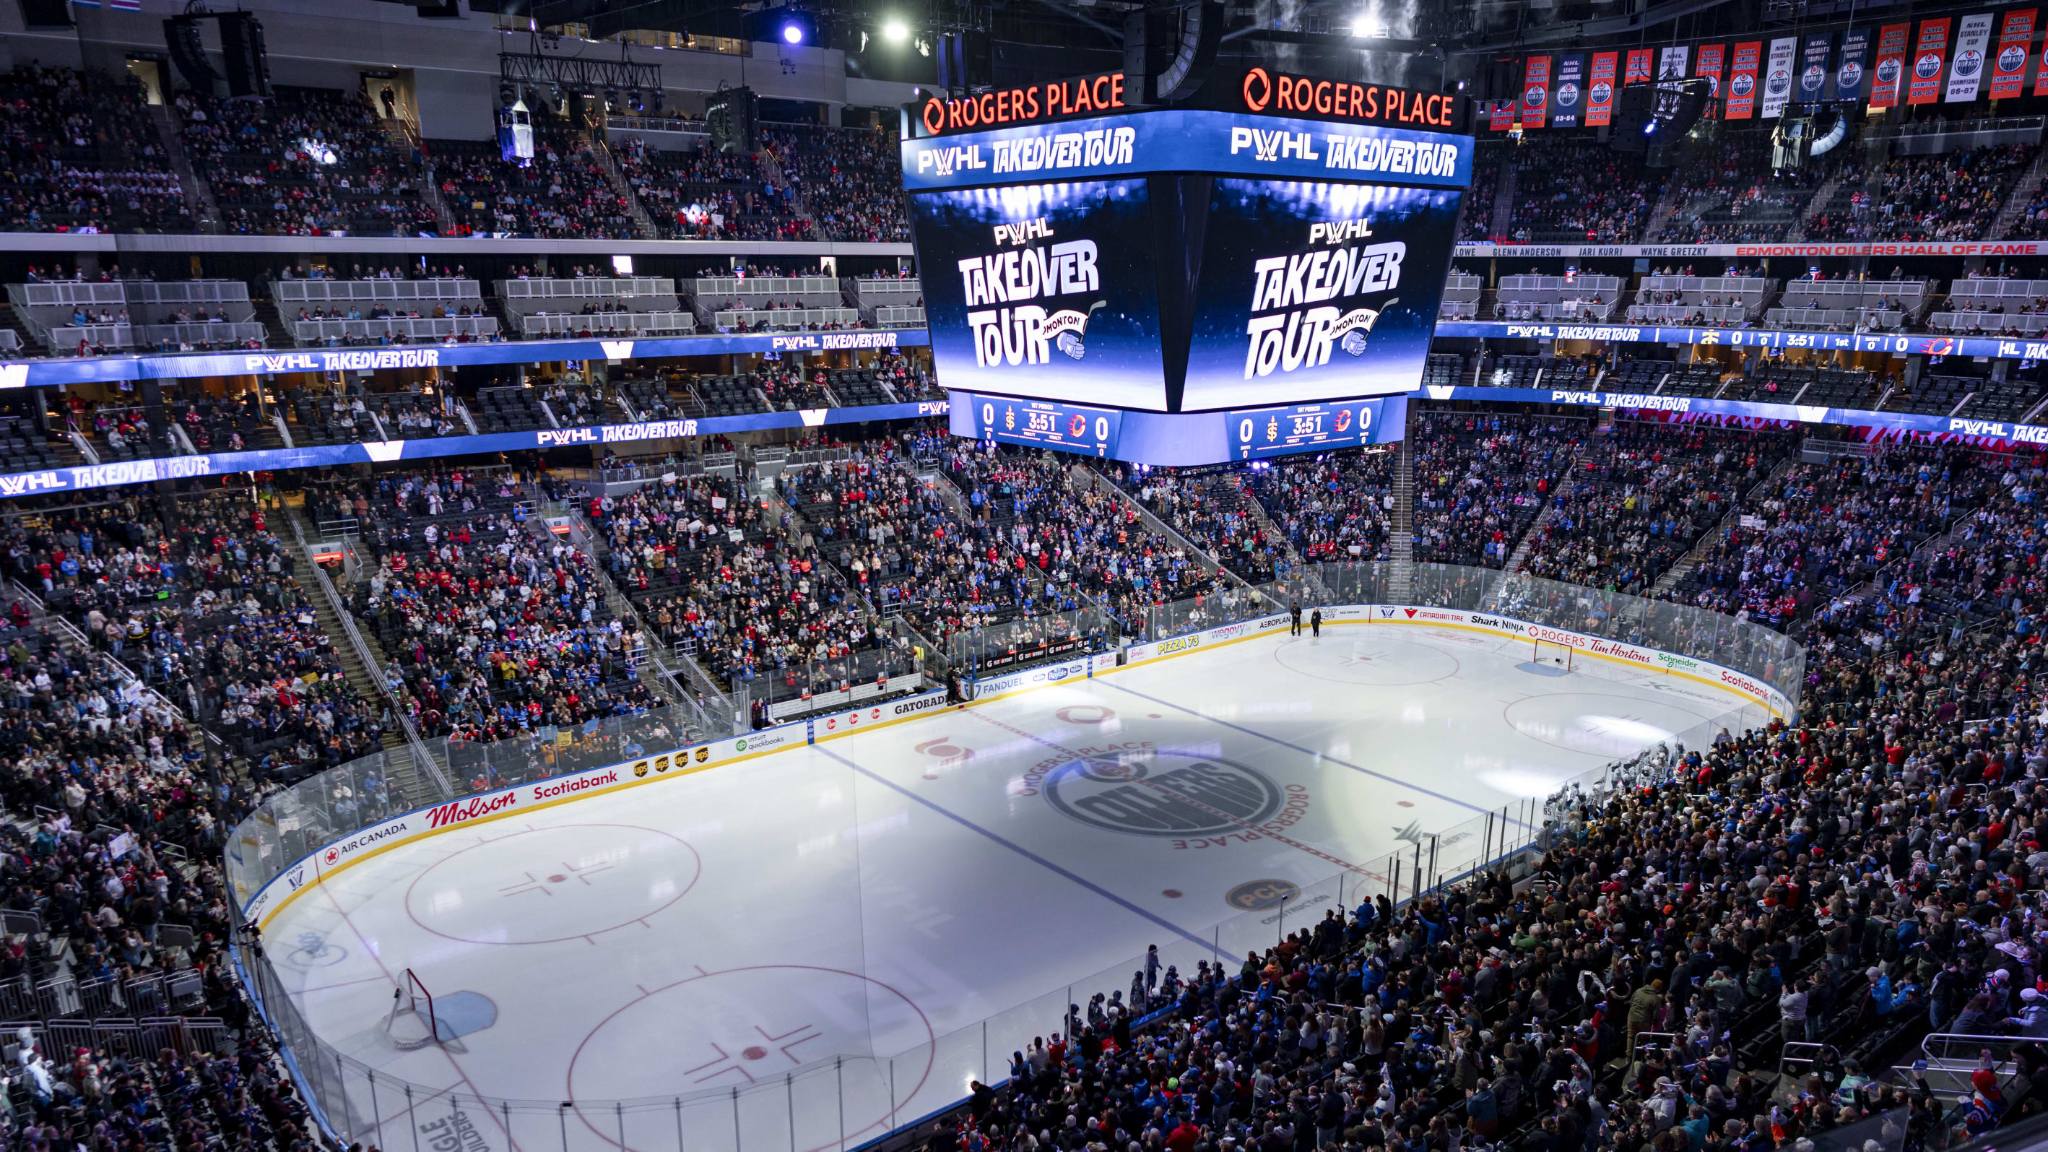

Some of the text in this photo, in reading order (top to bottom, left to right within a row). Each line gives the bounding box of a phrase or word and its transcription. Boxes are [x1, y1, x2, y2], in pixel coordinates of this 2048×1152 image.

[1960, 29, 1988, 38] STANLEY
[2002, 33, 2031, 43] DIVISION
[1966, 38, 1979, 46] CUP
[1770, 52, 1793, 60] STANLEY
[1807, 54, 1825, 62] TROPHY
[1957, 58, 1979, 67] OILERS
[2001, 55, 2024, 64] OILERS
[1917, 61, 1940, 71] OILERS
[1592, 71, 1614, 79] DIVISION
[1950, 78, 1979, 86] CHAMPIONS
[1993, 74, 2023, 83] CHAMPIONS
[1911, 81, 1939, 89] CHAMPIONS
[1950, 87, 1975, 95] 86-87
[950, 72, 1125, 130] ROGERS PLACE
[1277, 74, 1453, 127] ROGERS PLACE
[1230, 126, 1319, 162] PWHL
[918, 144, 987, 176] PWHL
[994, 217, 1054, 246] PWHL
[1309, 217, 1372, 244] PWHL
[1455, 244, 2039, 256] LOWE GLENN ANDERSON JARI KURRI WAYNE GRETZKY EDMONTON OILERS HALL OF FAME
[958, 238, 1100, 308] TAKEOVER
[1253, 240, 1407, 312] TAKEOVER
[966, 304, 1049, 369] TOUR
[1507, 325, 1554, 338] PWHL
[1731, 330, 1742, 344] 0
[772, 336, 820, 351] PWHL
[1243, 305, 1338, 381] TOUR
[1786, 334, 1816, 347] 3:51
[1834, 337, 1849, 347] 1st
[1867, 342, 1876, 350] 0
[1896, 337, 1909, 352] 0
[246, 355, 319, 372] PWHL
[1552, 390, 1600, 404] PWHL
[983, 402, 994, 426] 0
[1028, 412, 1056, 432] 3:51
[1359, 406, 1372, 430] 0
[1095, 416, 1108, 441] 0
[1239, 418, 1254, 443] 0
[1293, 415, 1322, 435] 3:51
[1949, 418, 2008, 437] PWHL
[537, 429, 598, 446] PWHL
[1099, 448, 1105, 457] 0
[1259, 616, 1291, 629] AEROPLAN
[1419, 611, 1464, 622] CANADIAN TIRE
[1471, 616, 1524, 632] Shark NINJA
[1211, 623, 1245, 640] wegovy
[1541, 628, 1585, 647] ROGERS
[1158, 635, 1199, 655] PIZZA 73
[1590, 638, 1651, 663] Tim Hortons
[1130, 648, 1145, 659] Barbie
[1658, 652, 1698, 669] Schneider
[983, 677, 1024, 694] FANDUEL
[1721, 671, 1769, 700] Scotiabank
[748, 736, 784, 751] quickbooks
[1077, 741, 1153, 757] PLACE
[675, 753, 688, 767] ups
[695, 748, 709, 762] ups
[634, 763, 648, 777] ups
[655, 758, 669, 773] ups
[534, 770, 618, 800] Scotiabank
[425, 792, 516, 829] Molson
[1171, 791, 1310, 850] ROGERS PLACE
[340, 822, 407, 856] AIR CANADA
[1238, 884, 1291, 906] PCL
[1260, 893, 1331, 925] CONSTRUCTION
